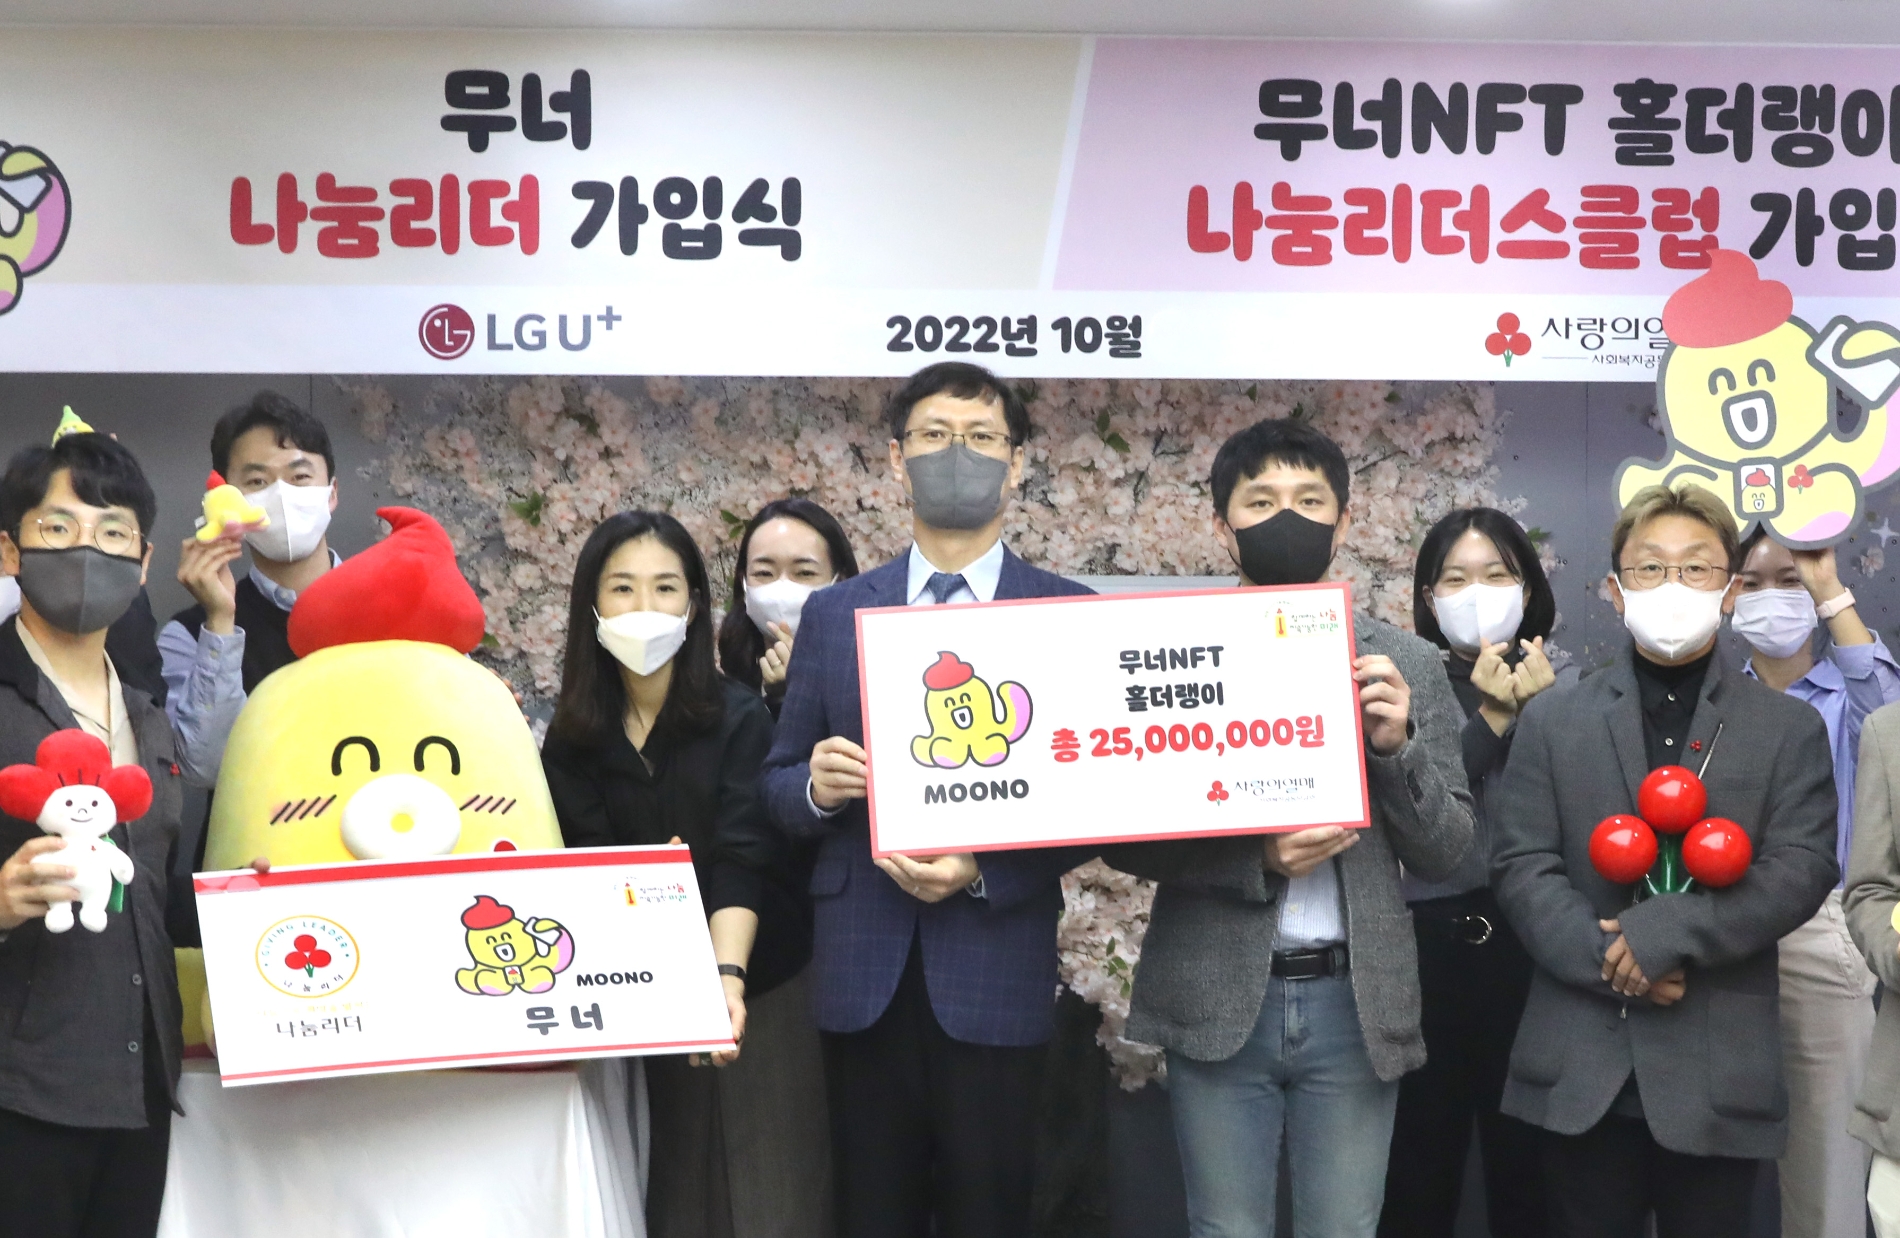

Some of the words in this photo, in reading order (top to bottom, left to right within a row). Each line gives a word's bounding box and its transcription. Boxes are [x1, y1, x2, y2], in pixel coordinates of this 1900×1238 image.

[440, 68, 592, 154] 무너
[1253, 77, 1584, 162] 무너NFT
[229, 171, 540, 260] 나눔리더
[570, 175, 802, 262] 가입식
[1186, 180, 1720, 270] 나눔리더스클럽
[1748, 186, 1897, 271] 가입
[886, 314, 1038, 358] 2022년
[1050, 314, 1142, 359] 10월
[1119, 645, 1224, 675] 무너NFT
[1124, 681, 1224, 713] 홀더랭이
[1050, 727, 1082, 763] 총
[1089, 714, 1325, 762] 25,000,000원
[924, 778, 1030, 804] MOONO
[576, 971, 654, 987] MOONO
